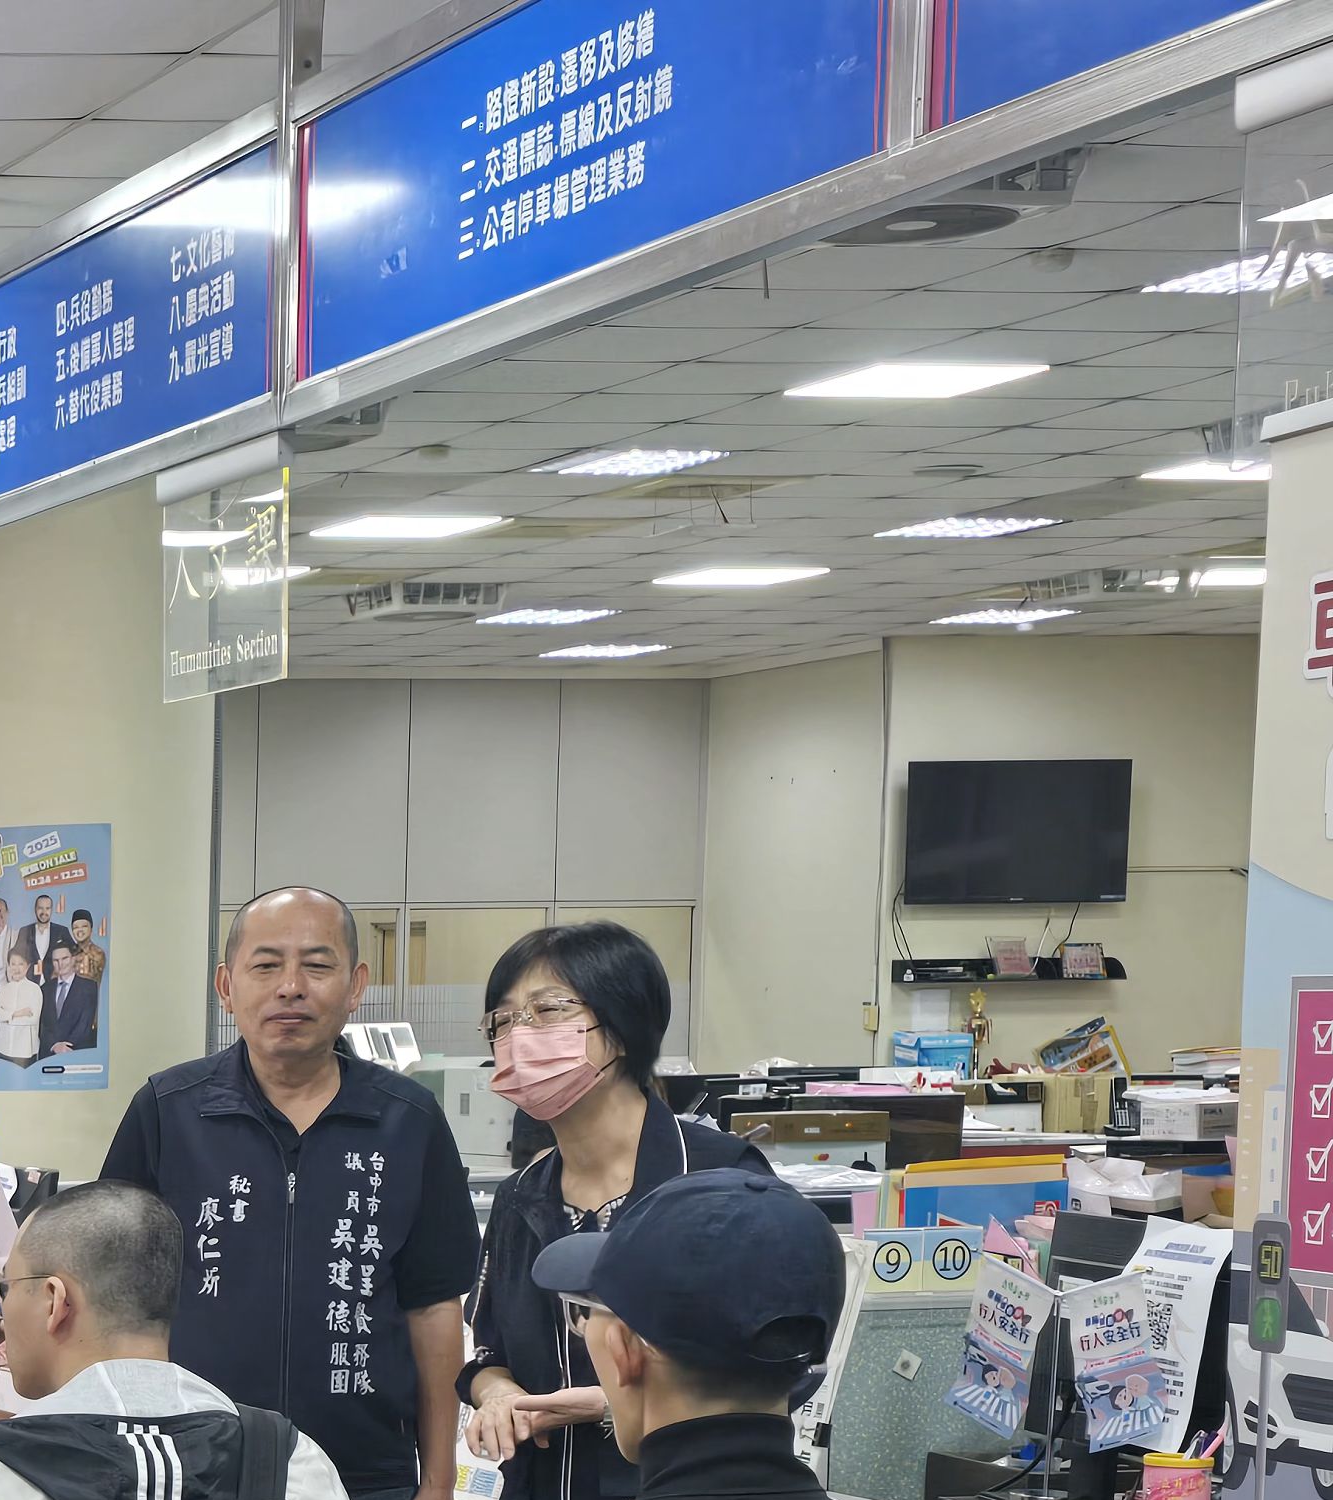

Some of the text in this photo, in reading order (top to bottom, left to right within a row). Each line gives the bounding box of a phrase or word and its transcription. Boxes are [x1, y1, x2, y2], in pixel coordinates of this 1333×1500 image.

[170, 630, 278, 676] Humanities Section
[27, 835, 58, 854] 2025
[229, 1174, 251, 1222] 秘書
[326, 1218, 355, 1334] 吳建德
[979, 1303, 1030, 1344] 行人安全行
[1080, 1321, 1141, 1352] 行人安全行
